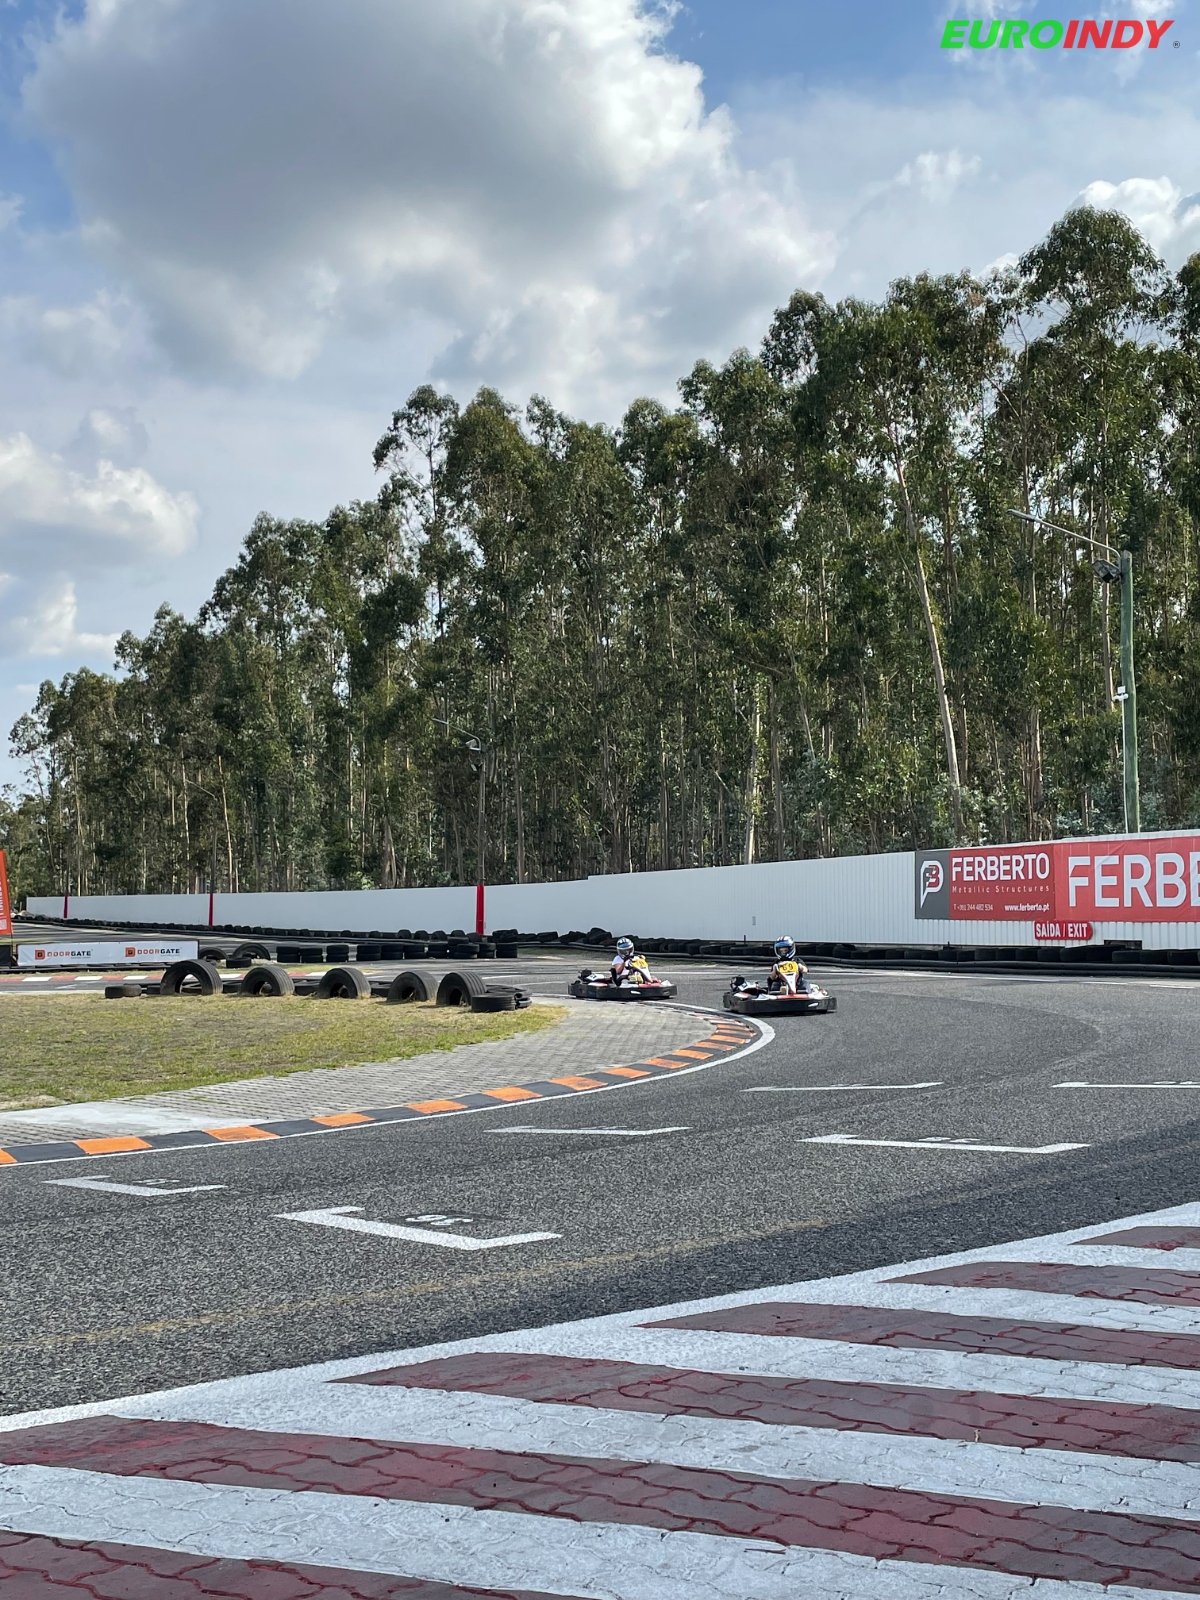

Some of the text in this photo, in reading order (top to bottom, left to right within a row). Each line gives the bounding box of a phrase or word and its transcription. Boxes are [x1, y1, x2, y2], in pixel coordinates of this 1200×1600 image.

[952, 853, 1050, 881] FERBERTO
[952, 885, 1050, 893] Metallic Structures
[1036, 920, 1061, 938] SAÍDA
[1067, 923, 1088, 938] EXIT
